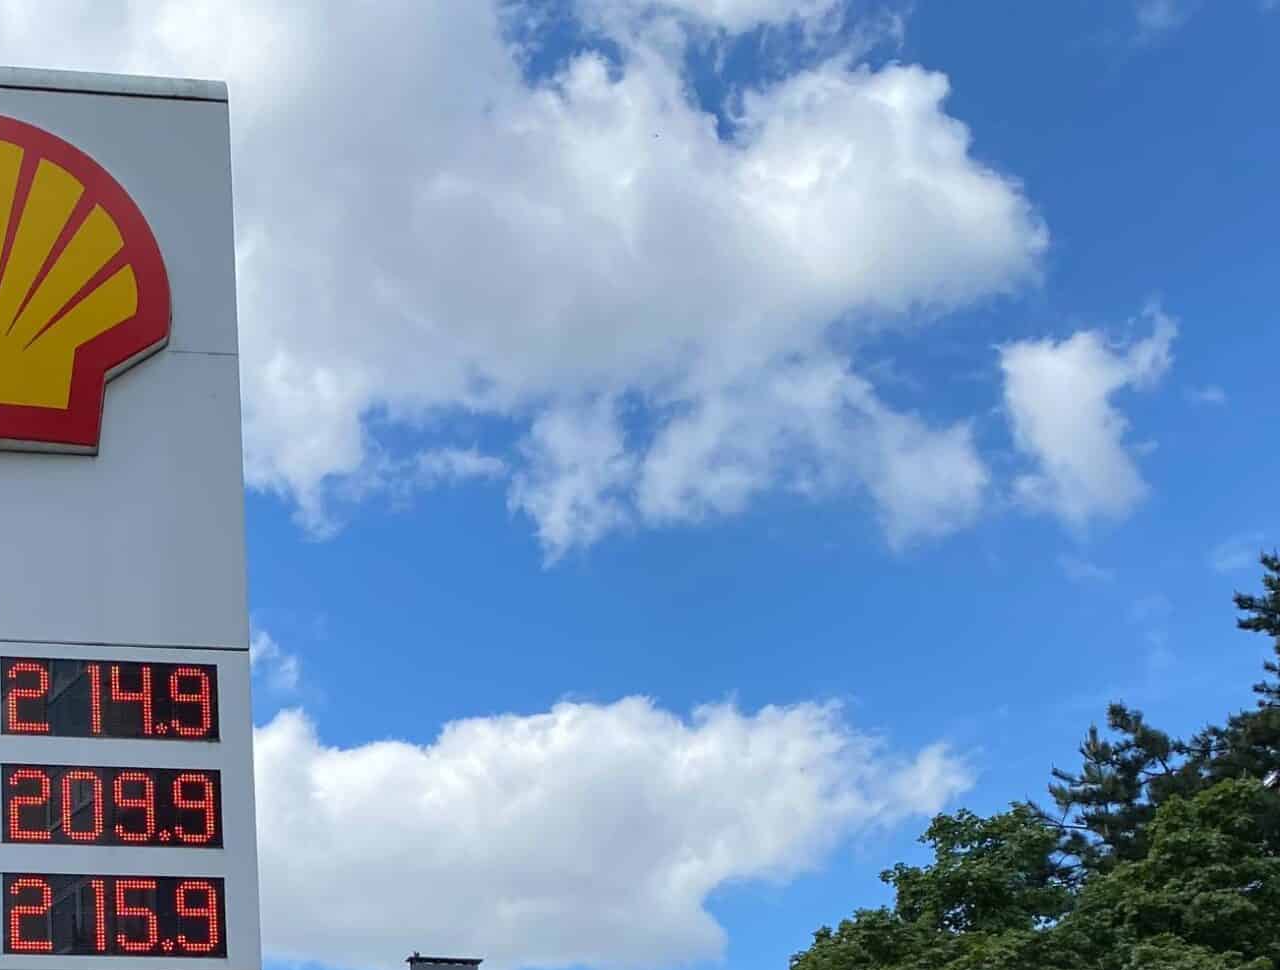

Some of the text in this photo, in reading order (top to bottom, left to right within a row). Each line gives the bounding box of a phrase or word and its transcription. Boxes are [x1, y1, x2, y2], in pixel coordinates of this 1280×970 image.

[8, 663, 211, 737] 214.9
[9, 769, 215, 843] 209.9
[10, 877, 218, 952] 215.9
